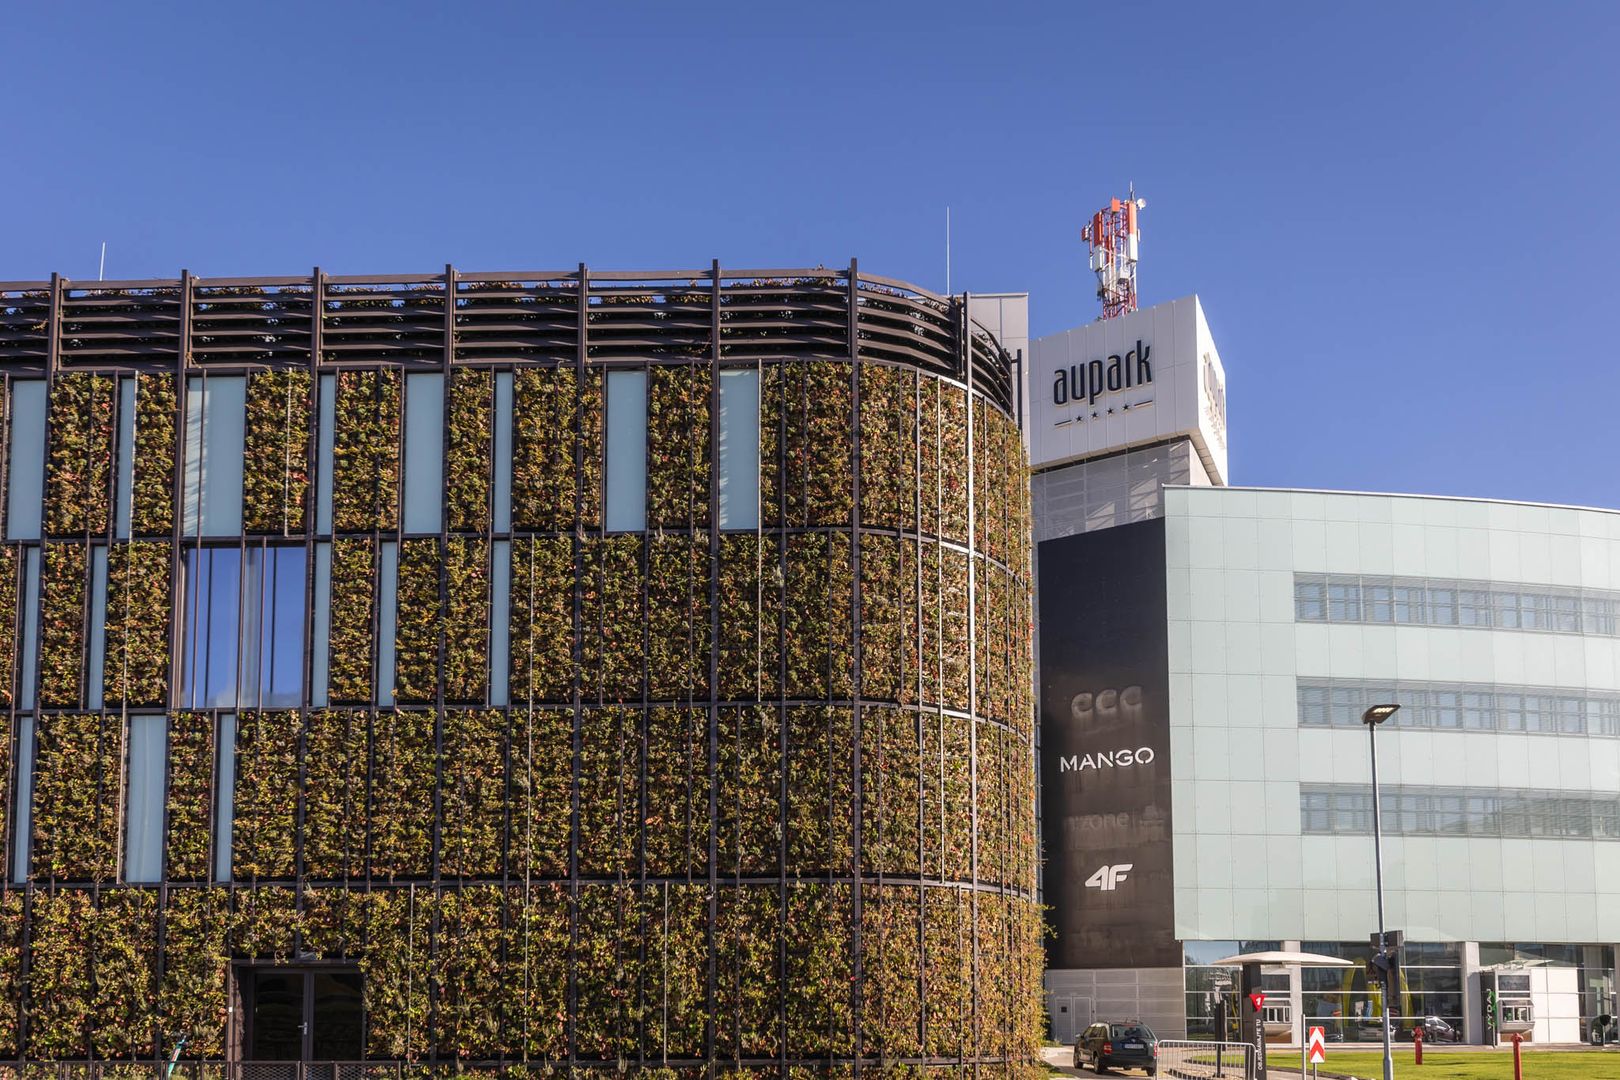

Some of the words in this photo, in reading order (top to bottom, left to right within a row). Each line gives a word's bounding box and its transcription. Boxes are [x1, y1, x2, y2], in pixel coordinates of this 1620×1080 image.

[1053, 340, 1153, 405] aupark
[1060, 747, 1155, 772] MANGO
[1085, 864, 1133, 890] 4F
[1256, 997, 1262, 1005] 1
